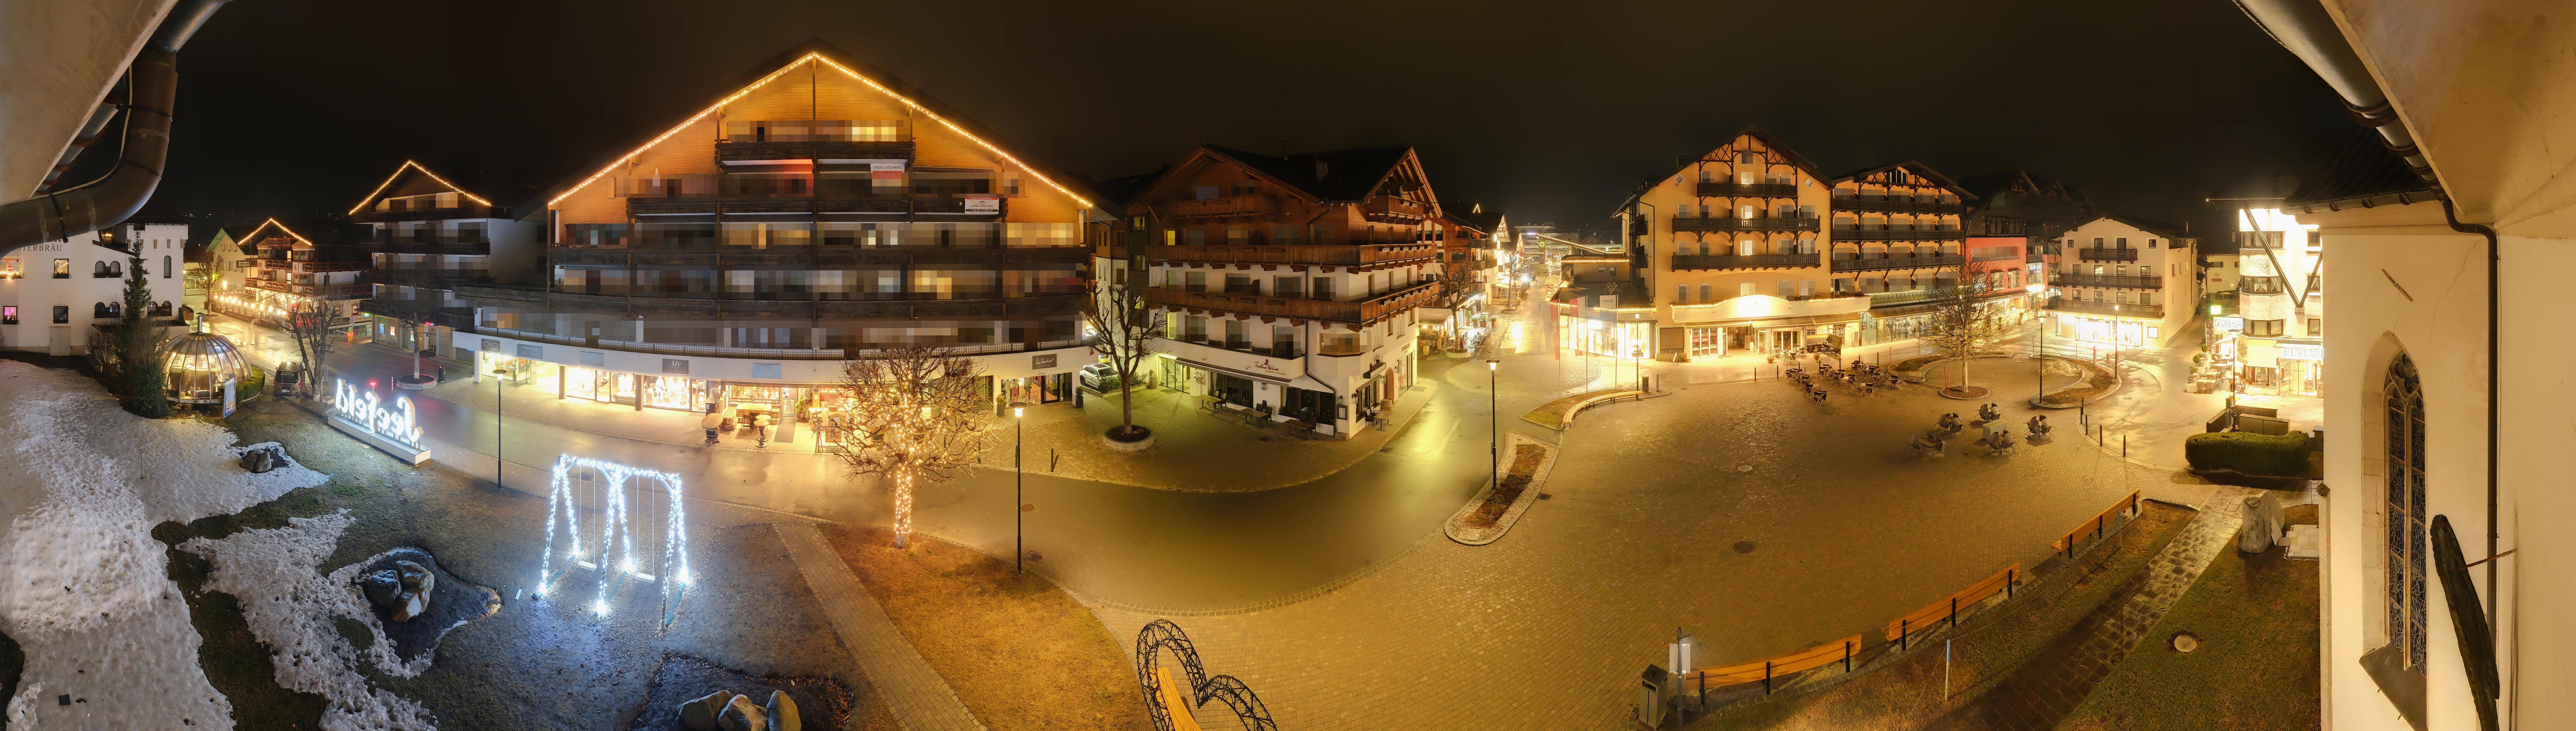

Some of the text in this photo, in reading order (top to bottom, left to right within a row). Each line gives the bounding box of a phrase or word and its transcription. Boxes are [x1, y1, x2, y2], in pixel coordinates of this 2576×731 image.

[1402, 343, 1410, 351] SAILER
[670, 361, 681, 370] My
[1371, 364, 1385, 377] RESTAURANT
